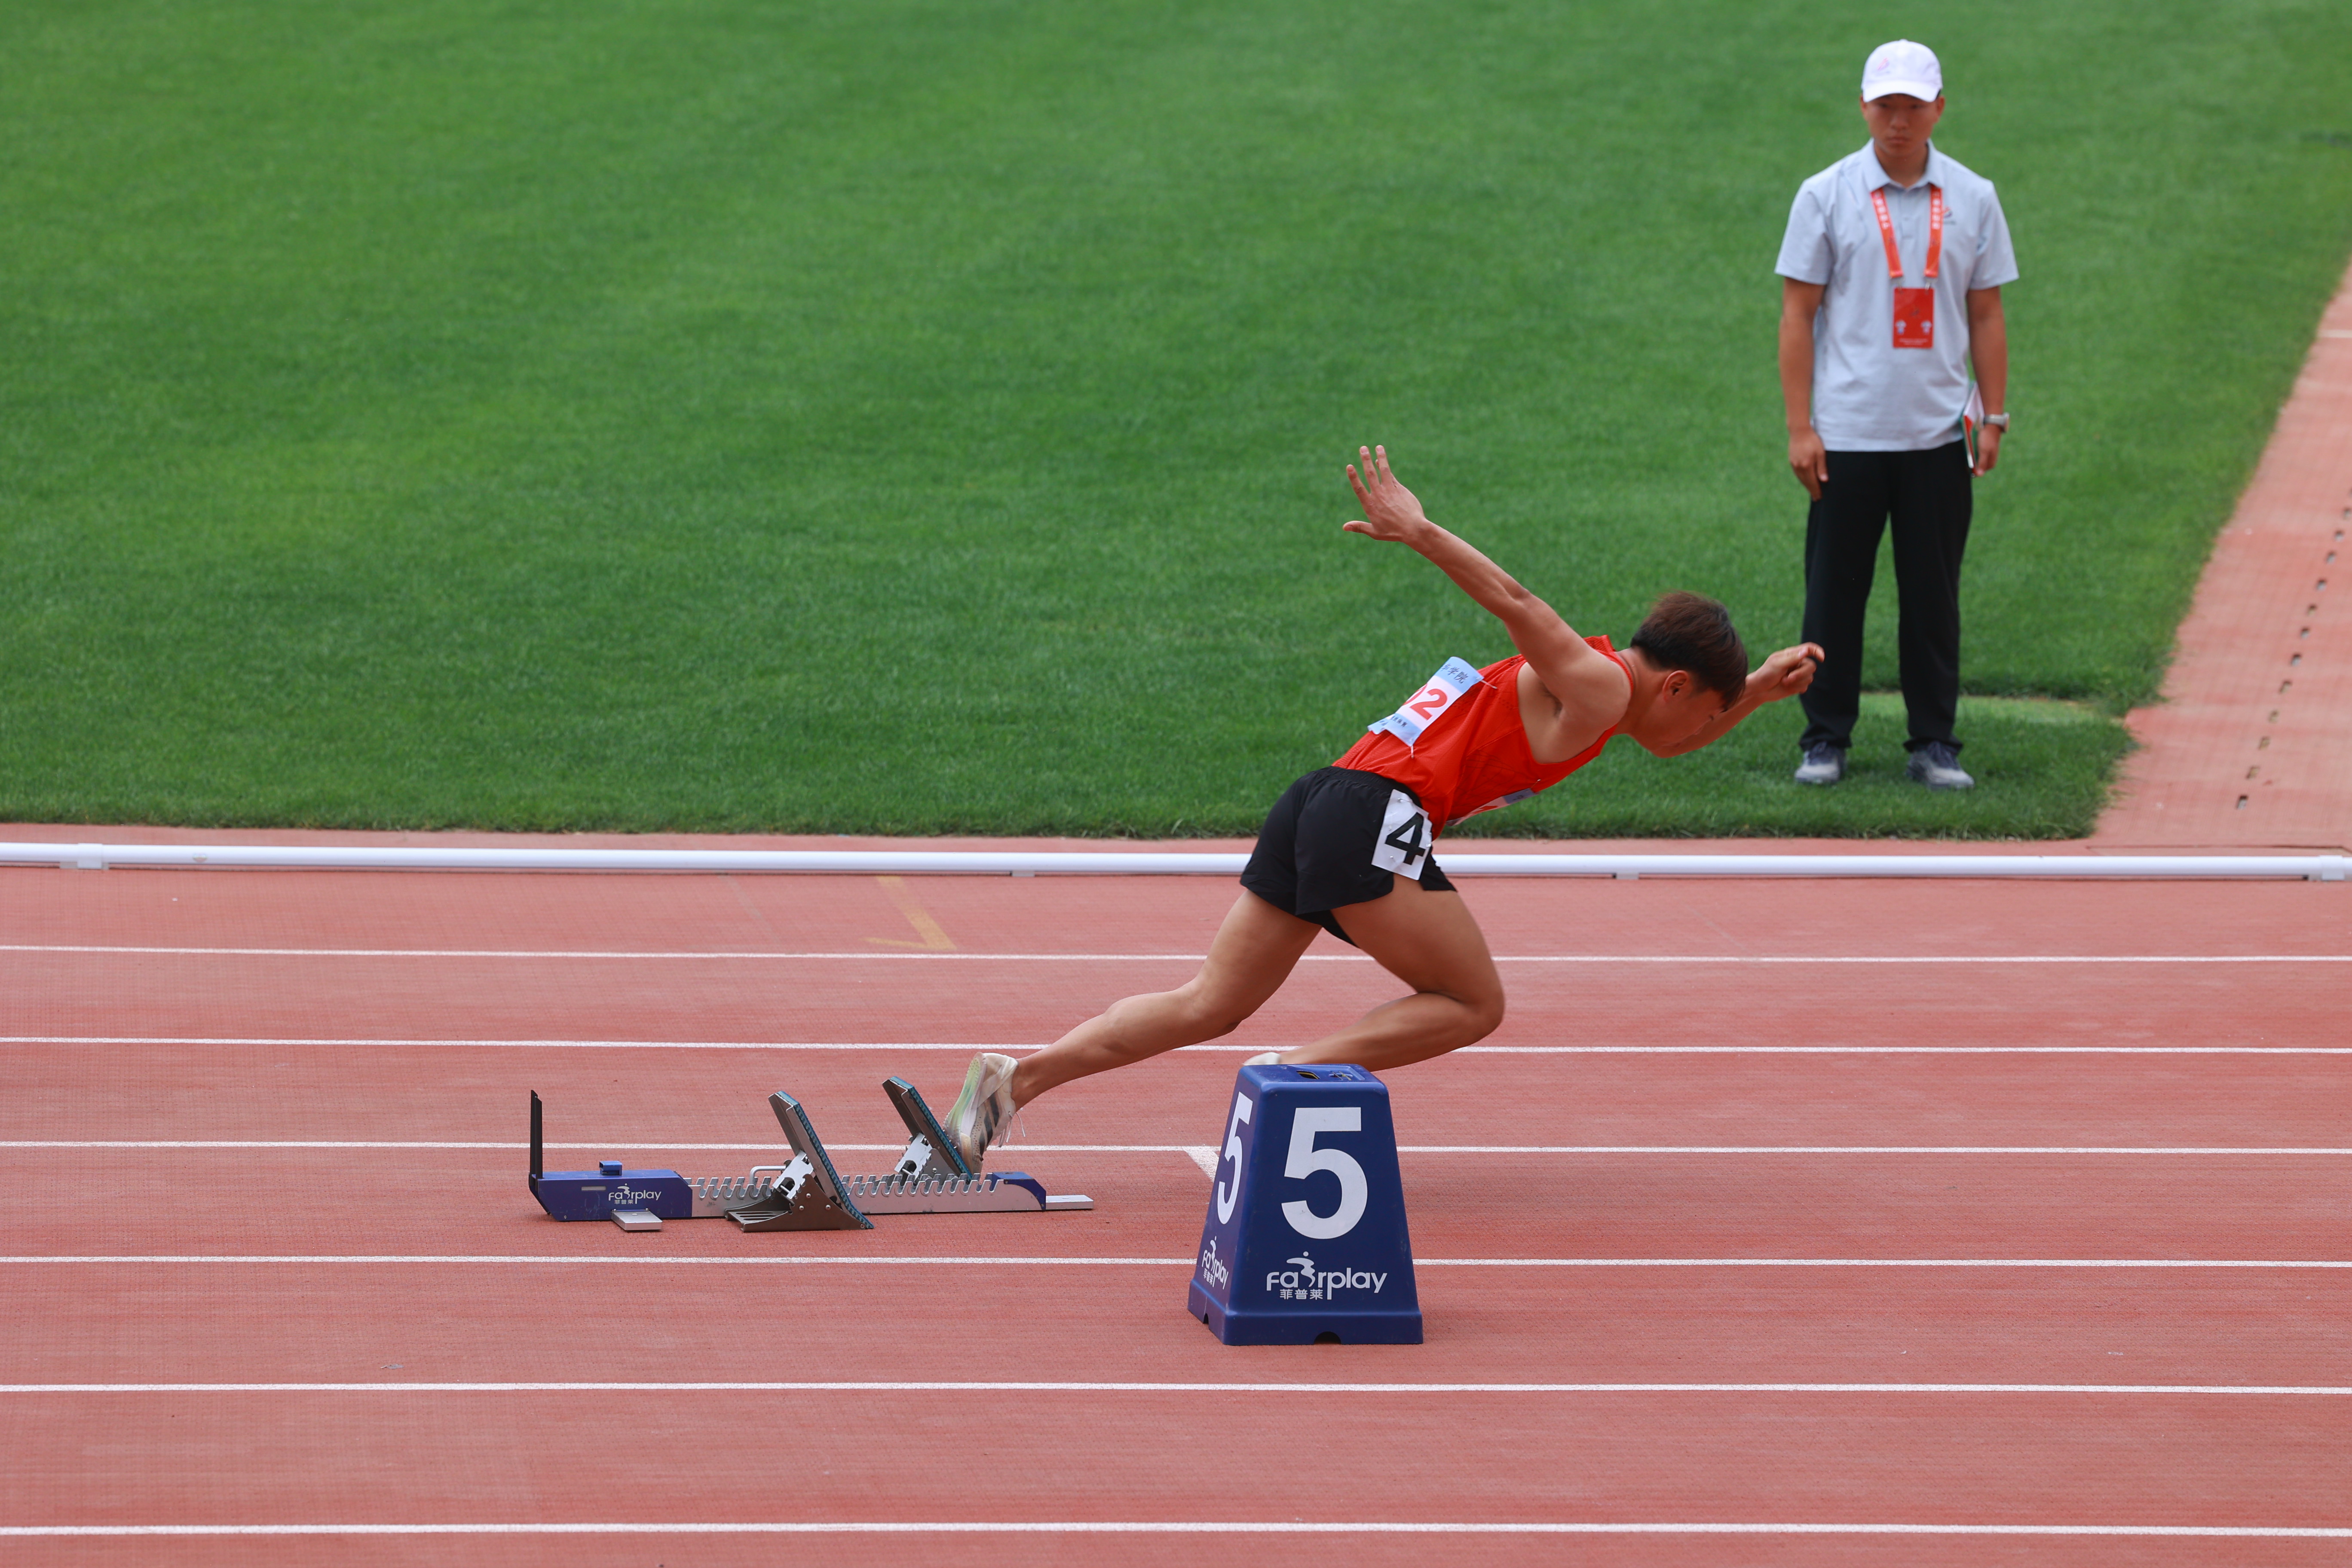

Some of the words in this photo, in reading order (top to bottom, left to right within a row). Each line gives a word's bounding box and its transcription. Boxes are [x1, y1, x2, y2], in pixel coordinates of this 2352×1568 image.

[1403, 683, 1448, 720] 2
[1385, 812, 1427, 865] 4
[1217, 1092, 1253, 1225] 5
[1281, 1107, 1368, 1239] 5
[608, 1183, 662, 1204] fairplay
[1266, 1251, 1387, 1300] fairplay
[1280, 1289, 1323, 1300] 菲普莱
